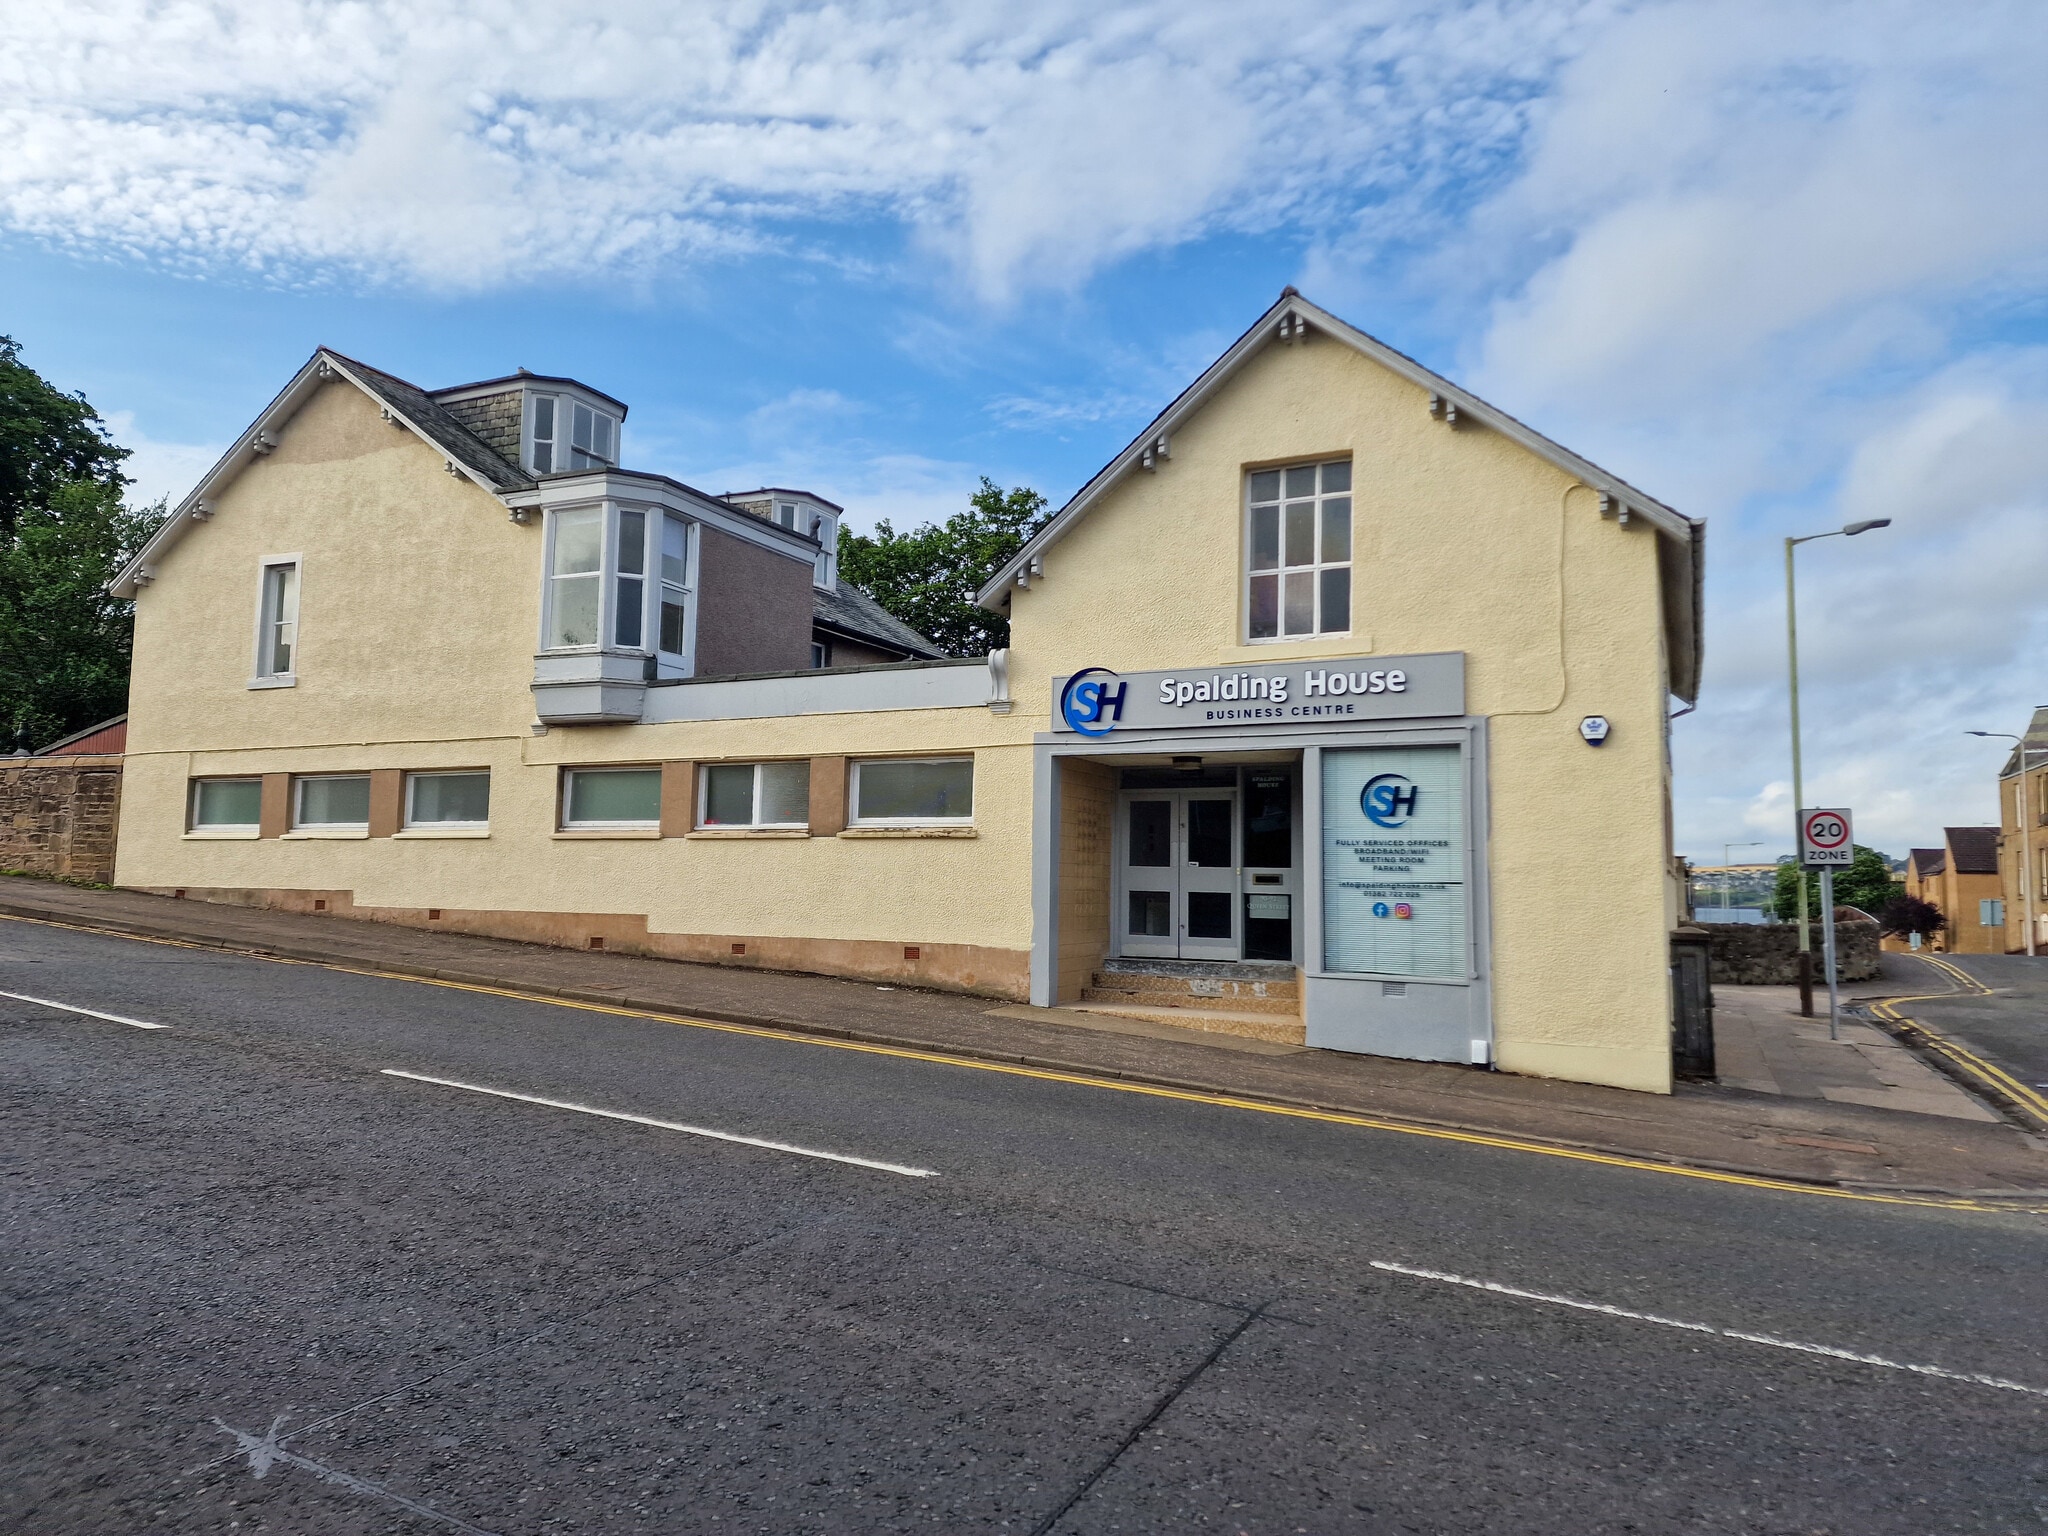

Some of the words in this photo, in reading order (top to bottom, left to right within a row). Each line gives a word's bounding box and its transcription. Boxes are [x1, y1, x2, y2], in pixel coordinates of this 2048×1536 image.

[1159, 673, 1289, 707] Spalding
[1303, 669, 1406, 697] House
[1071, 681, 1127, 723] SH
[1206, 707, 1284, 721] BUSINESS
[1290, 704, 1356, 717] CENTRE
[1370, 785, 1418, 817] SH
[1813, 823, 1842, 837] 20
[1809, 851, 1848, 860] ZONE
